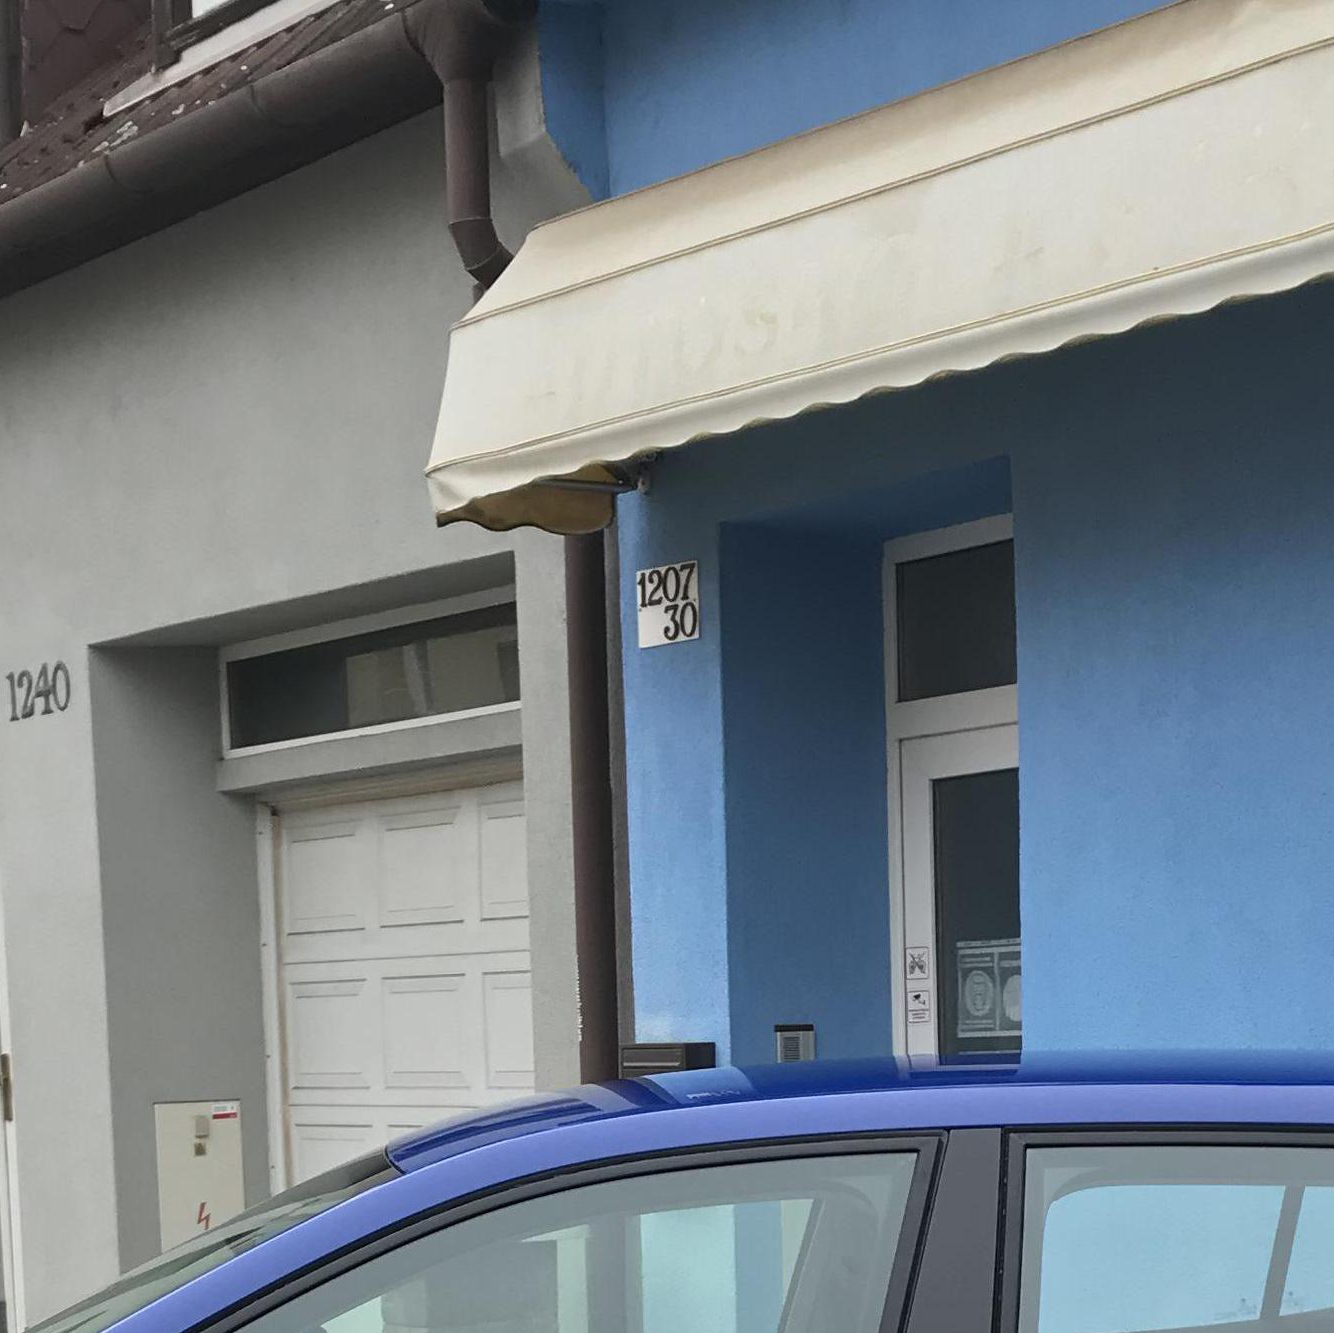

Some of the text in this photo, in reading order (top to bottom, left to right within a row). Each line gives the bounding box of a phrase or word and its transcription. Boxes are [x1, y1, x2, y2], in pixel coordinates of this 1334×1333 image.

[637, 563, 695, 608] 1207
[664, 602, 697, 641] 30
[5, 660, 71, 722] 1240
